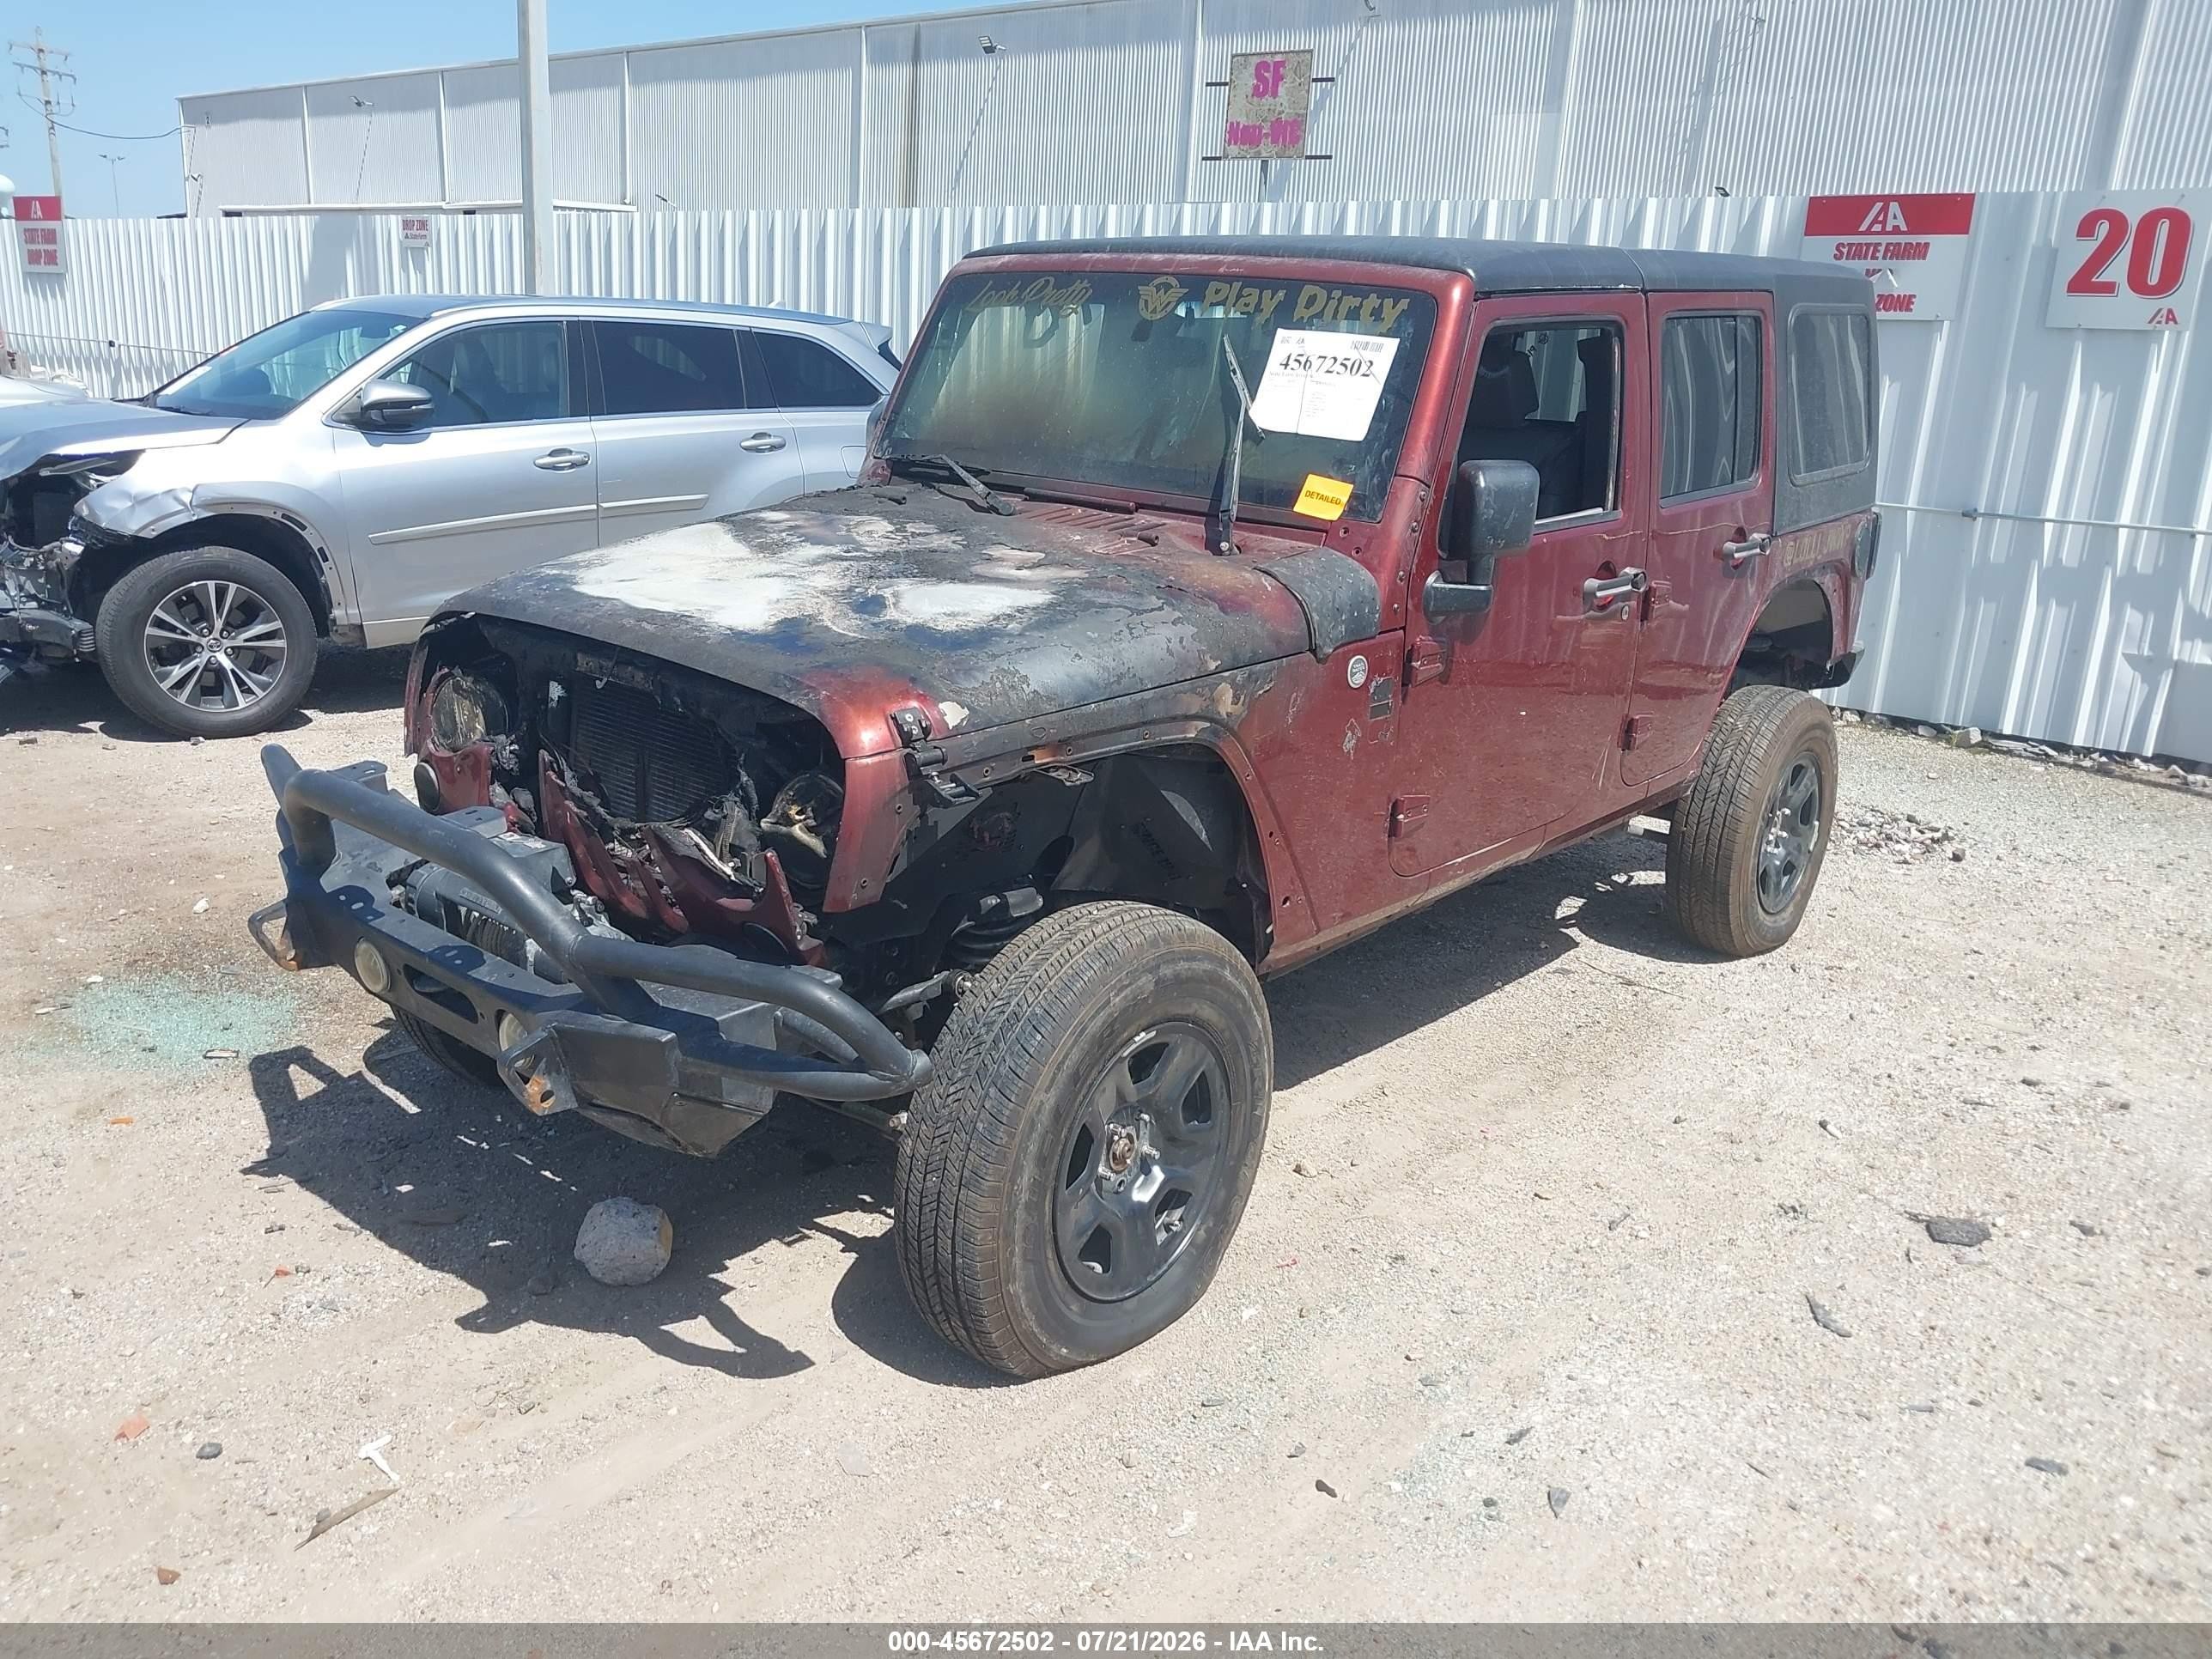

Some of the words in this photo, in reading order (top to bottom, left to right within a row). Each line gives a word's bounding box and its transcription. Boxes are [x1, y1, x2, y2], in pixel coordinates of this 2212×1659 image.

[1252, 59, 1286, 99] SF
[402, 219, 415, 231] DROP
[416, 219, 428, 232] ZONE
[23, 228, 40, 245] STATE
[41, 228, 58, 245] FARM
[27, 248, 42, 265] DROP
[43, 248, 58, 266] ZONE
[1833, 241, 1882, 261] STATE
[1881, 241, 1930, 261] FARM
[2065, 205, 2194, 300] 20
[963, 279, 1022, 313] Look
[1875, 293, 1917, 313] ZONE
[1200, 281, 1286, 329] Play
[1293, 284, 1410, 335] Dirty
[1279, 352, 1374, 378] 45672502
[1304, 489, 1342, 506] DETAILED
